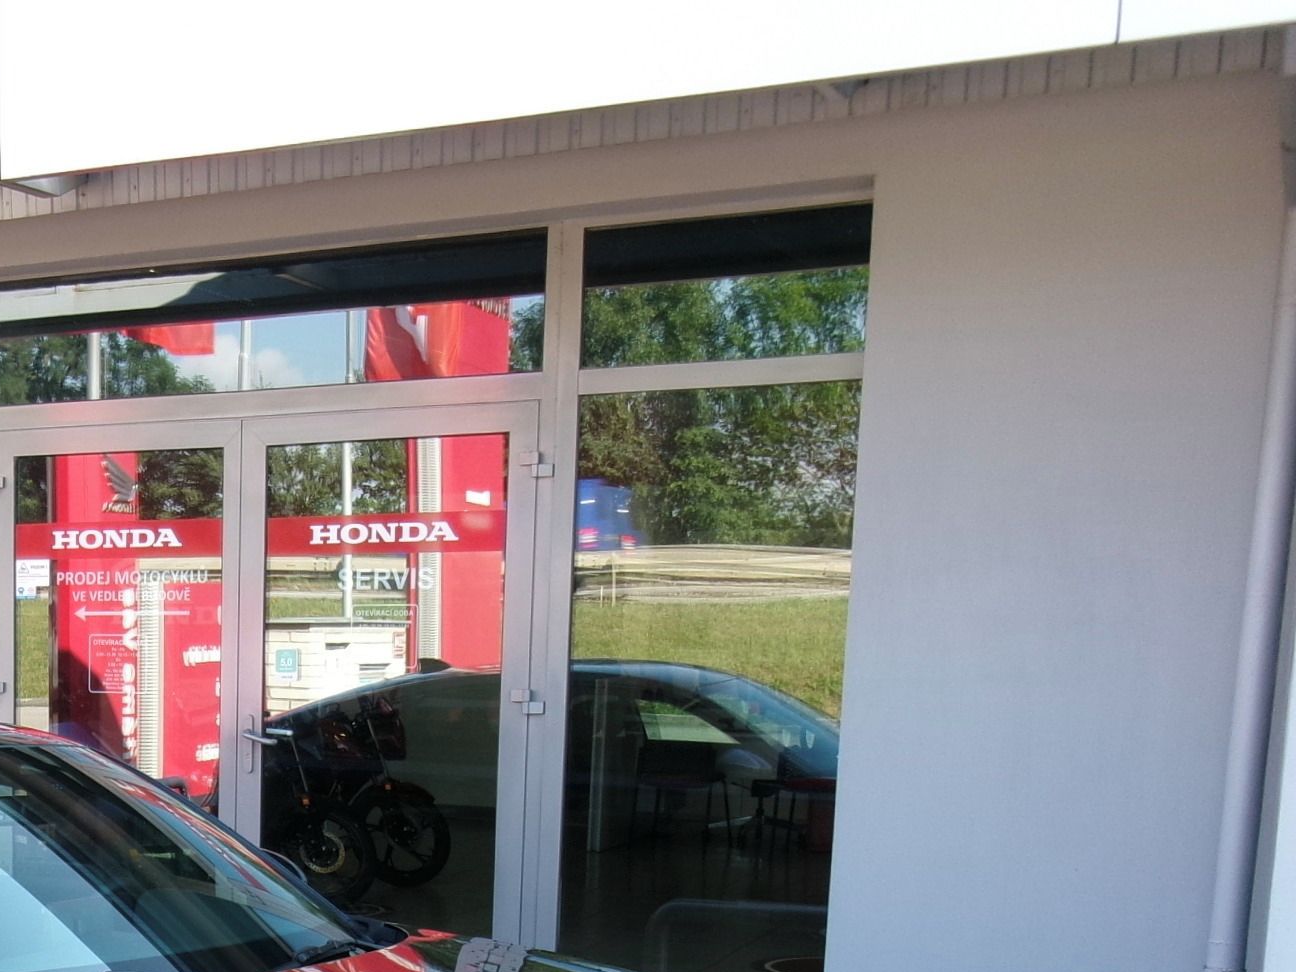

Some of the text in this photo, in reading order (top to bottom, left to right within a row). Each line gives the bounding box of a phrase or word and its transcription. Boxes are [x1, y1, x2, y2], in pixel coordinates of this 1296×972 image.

[52, 528, 183, 549] HONDA
[309, 521, 459, 544] HONDA
[56, 571, 110, 585] PRODEJ
[337, 567, 434, 591] SERVIS
[72, 590, 86, 602] VE
